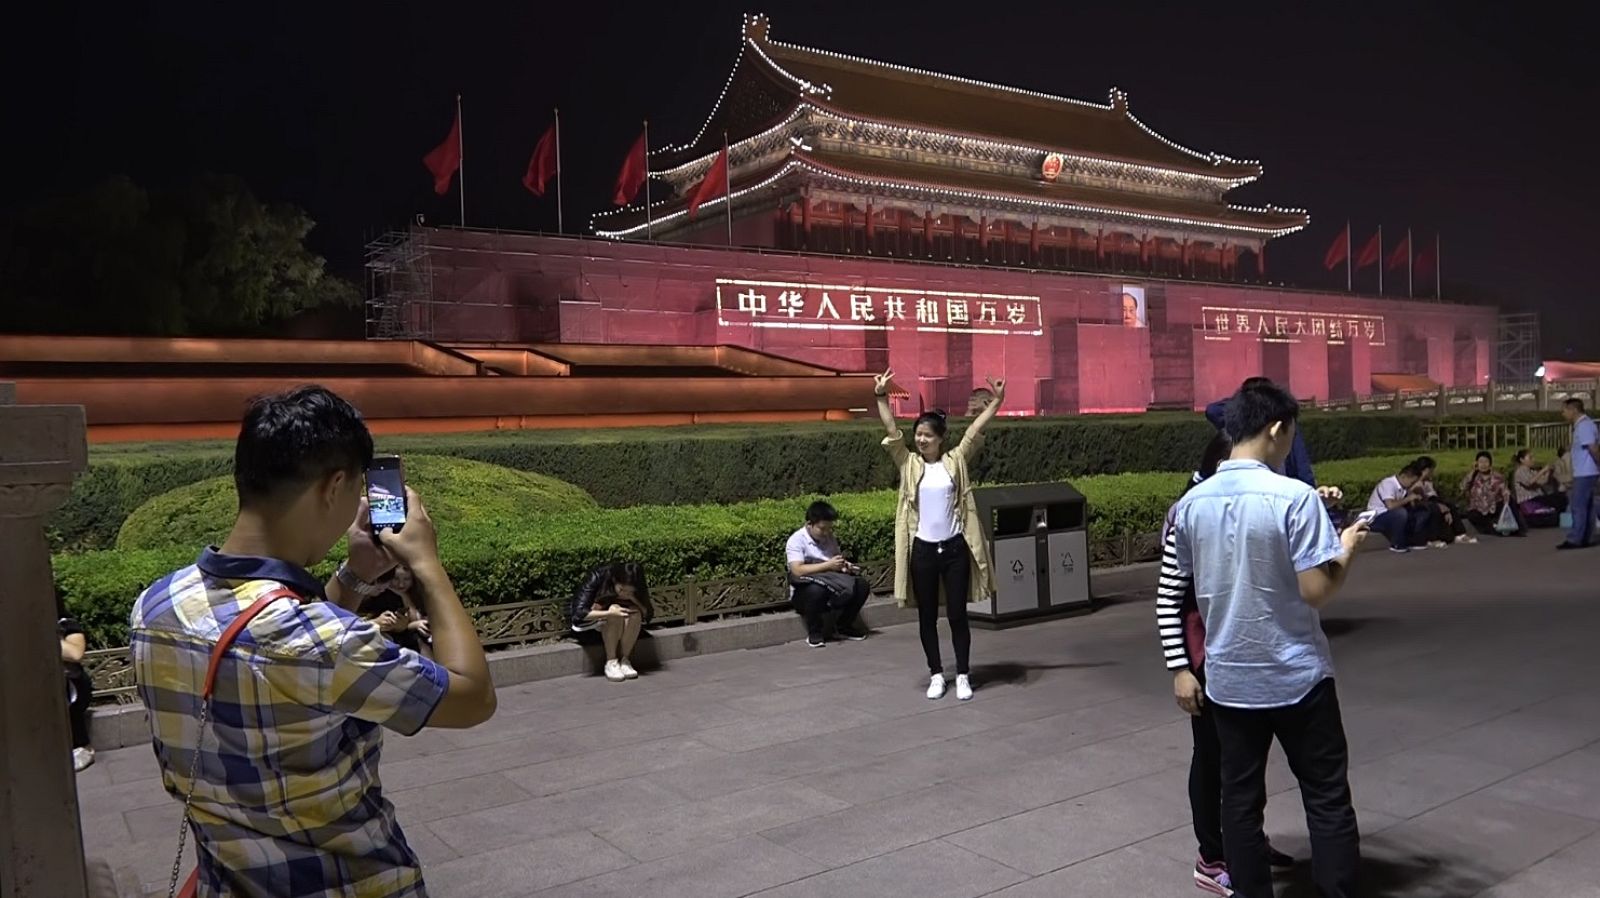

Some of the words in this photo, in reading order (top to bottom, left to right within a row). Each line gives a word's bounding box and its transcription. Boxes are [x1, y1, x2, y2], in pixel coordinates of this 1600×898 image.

[738, 288, 1026, 325] 中华人民共和国万岁
[1215, 313, 1376, 340] 世界人民大团结万岁
